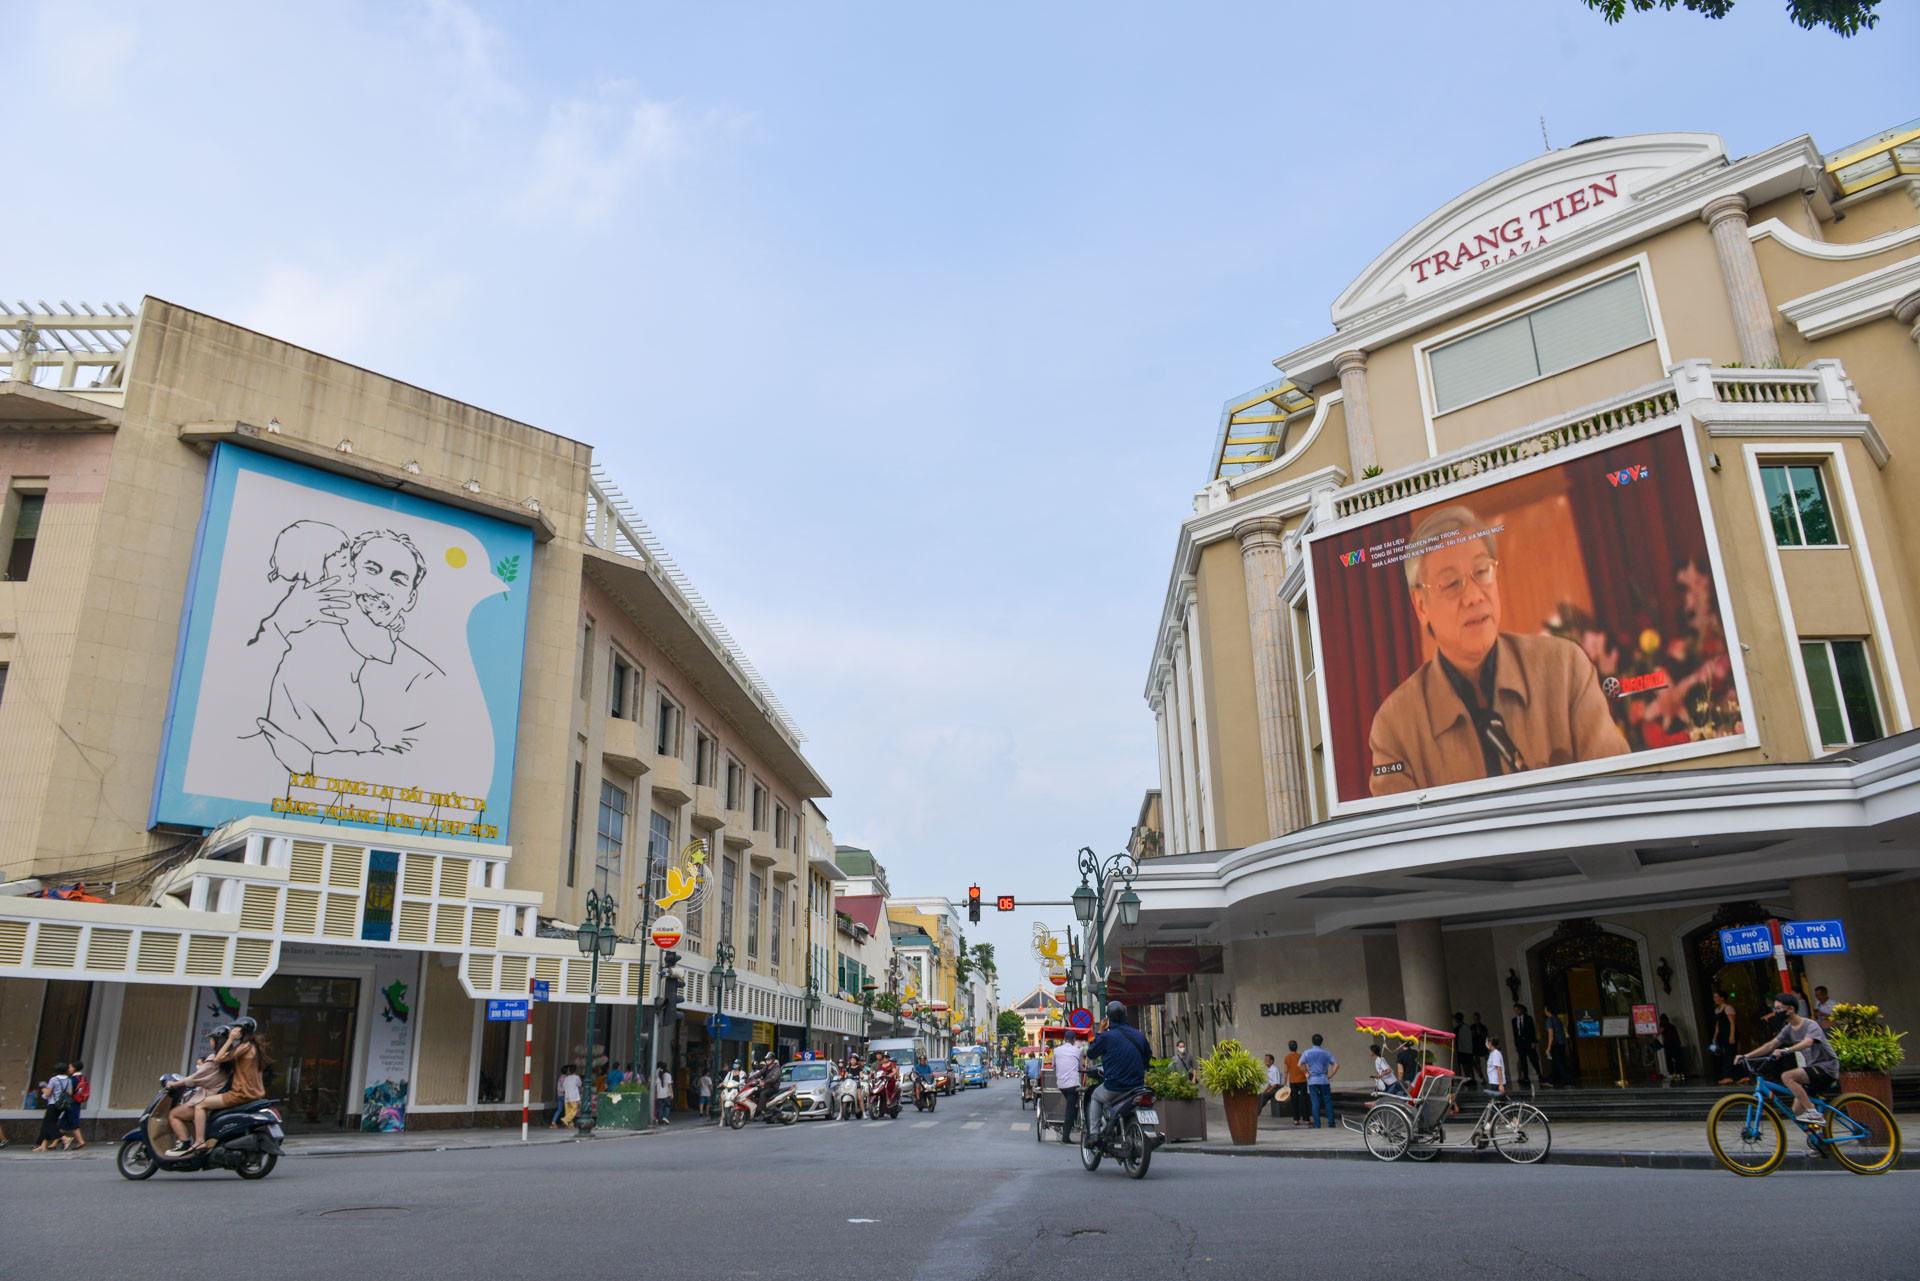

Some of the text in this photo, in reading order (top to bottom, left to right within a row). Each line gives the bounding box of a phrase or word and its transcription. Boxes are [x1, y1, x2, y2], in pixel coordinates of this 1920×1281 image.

[1410, 174, 1618, 283] TRANG TIEN
[1480, 235, 1548, 270] PLAZA
[1607, 465, 1640, 487] VOV
[1369, 544, 1383, 552] PHIM
[1375, 763, 1402, 775] 20:40
[289, 771, 319, 789] XÂY
[372, 783, 394, 801] LẠI
[401, 785, 425, 803] ĐẤT
[473, 797, 487, 812] TA
[420, 817, 437, 831] TO
[441, 819, 465, 836] ĐẸP
[999, 898, 1013, 910] 06
[1741, 930, 1758, 939] PHỐ
[1806, 922, 1826, 932] PHỐ
[1726, 937, 1770, 957] TRÀNG TIỀN
[1787, 934, 1842, 950] HÀNG BÀI
[1260, 999, 1343, 1017] BURBERRY
